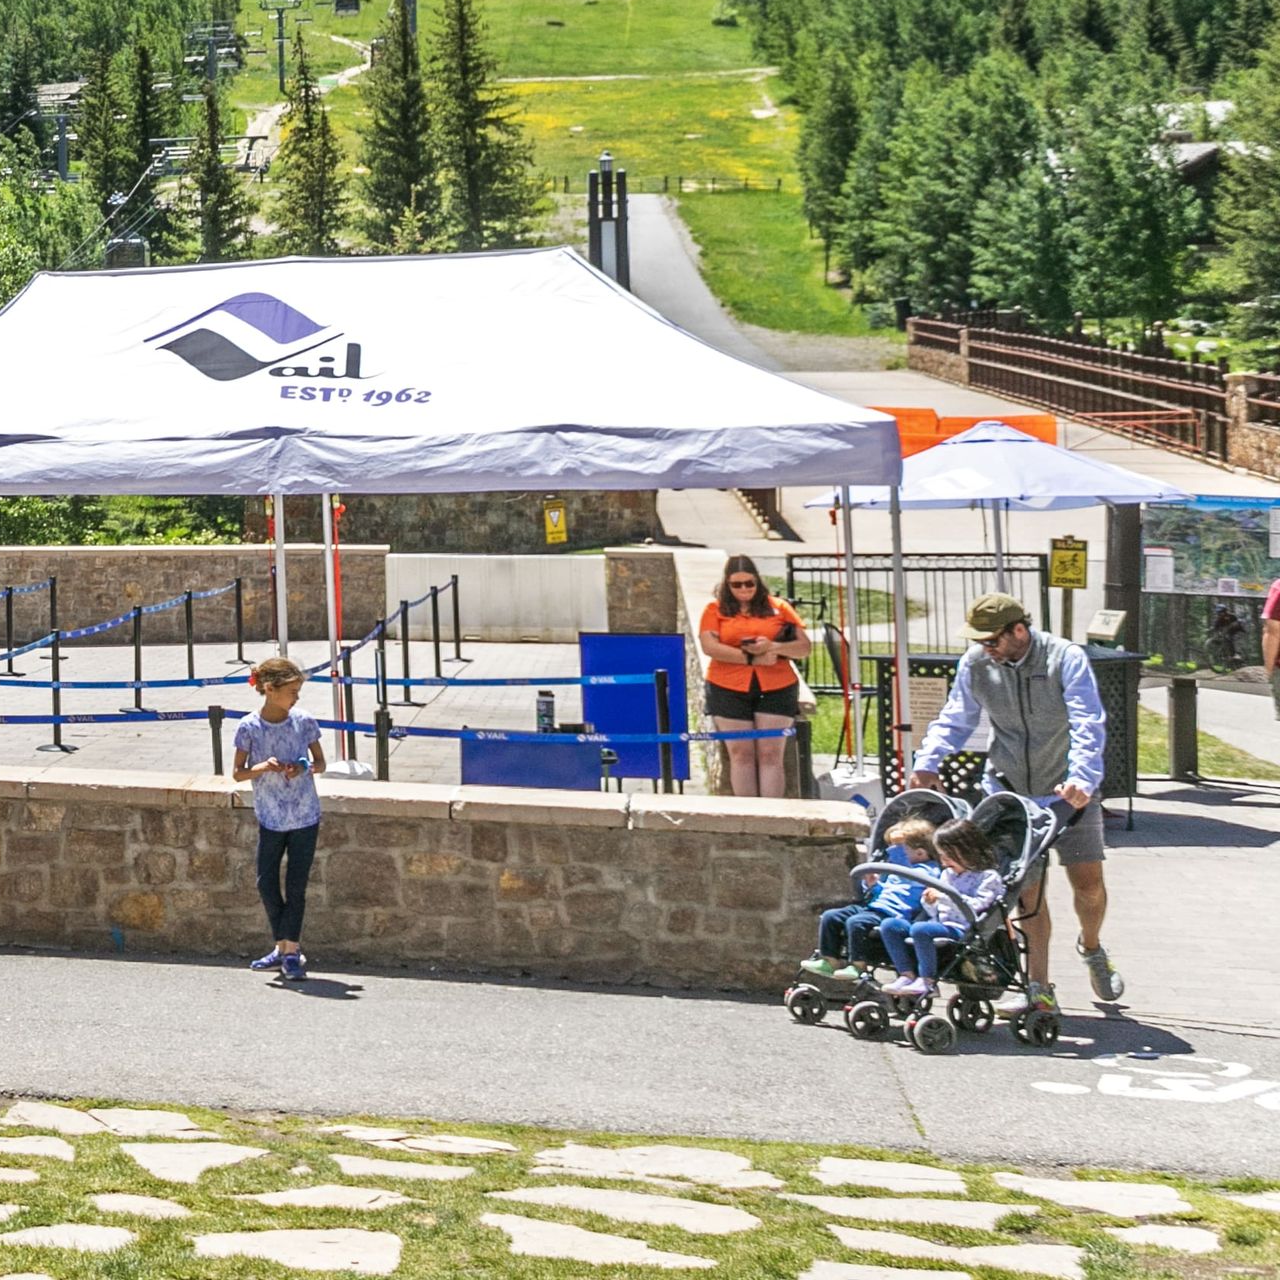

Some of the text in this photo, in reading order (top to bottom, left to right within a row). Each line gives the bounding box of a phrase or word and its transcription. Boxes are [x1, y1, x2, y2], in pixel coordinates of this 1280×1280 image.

[362, 387, 432, 407] 1962
[598, 676, 616, 684] VAIL
[76, 715, 96, 723] VAIL
[486, 732, 508, 740] VAIL
[588, 734, 611, 742] VAIL
